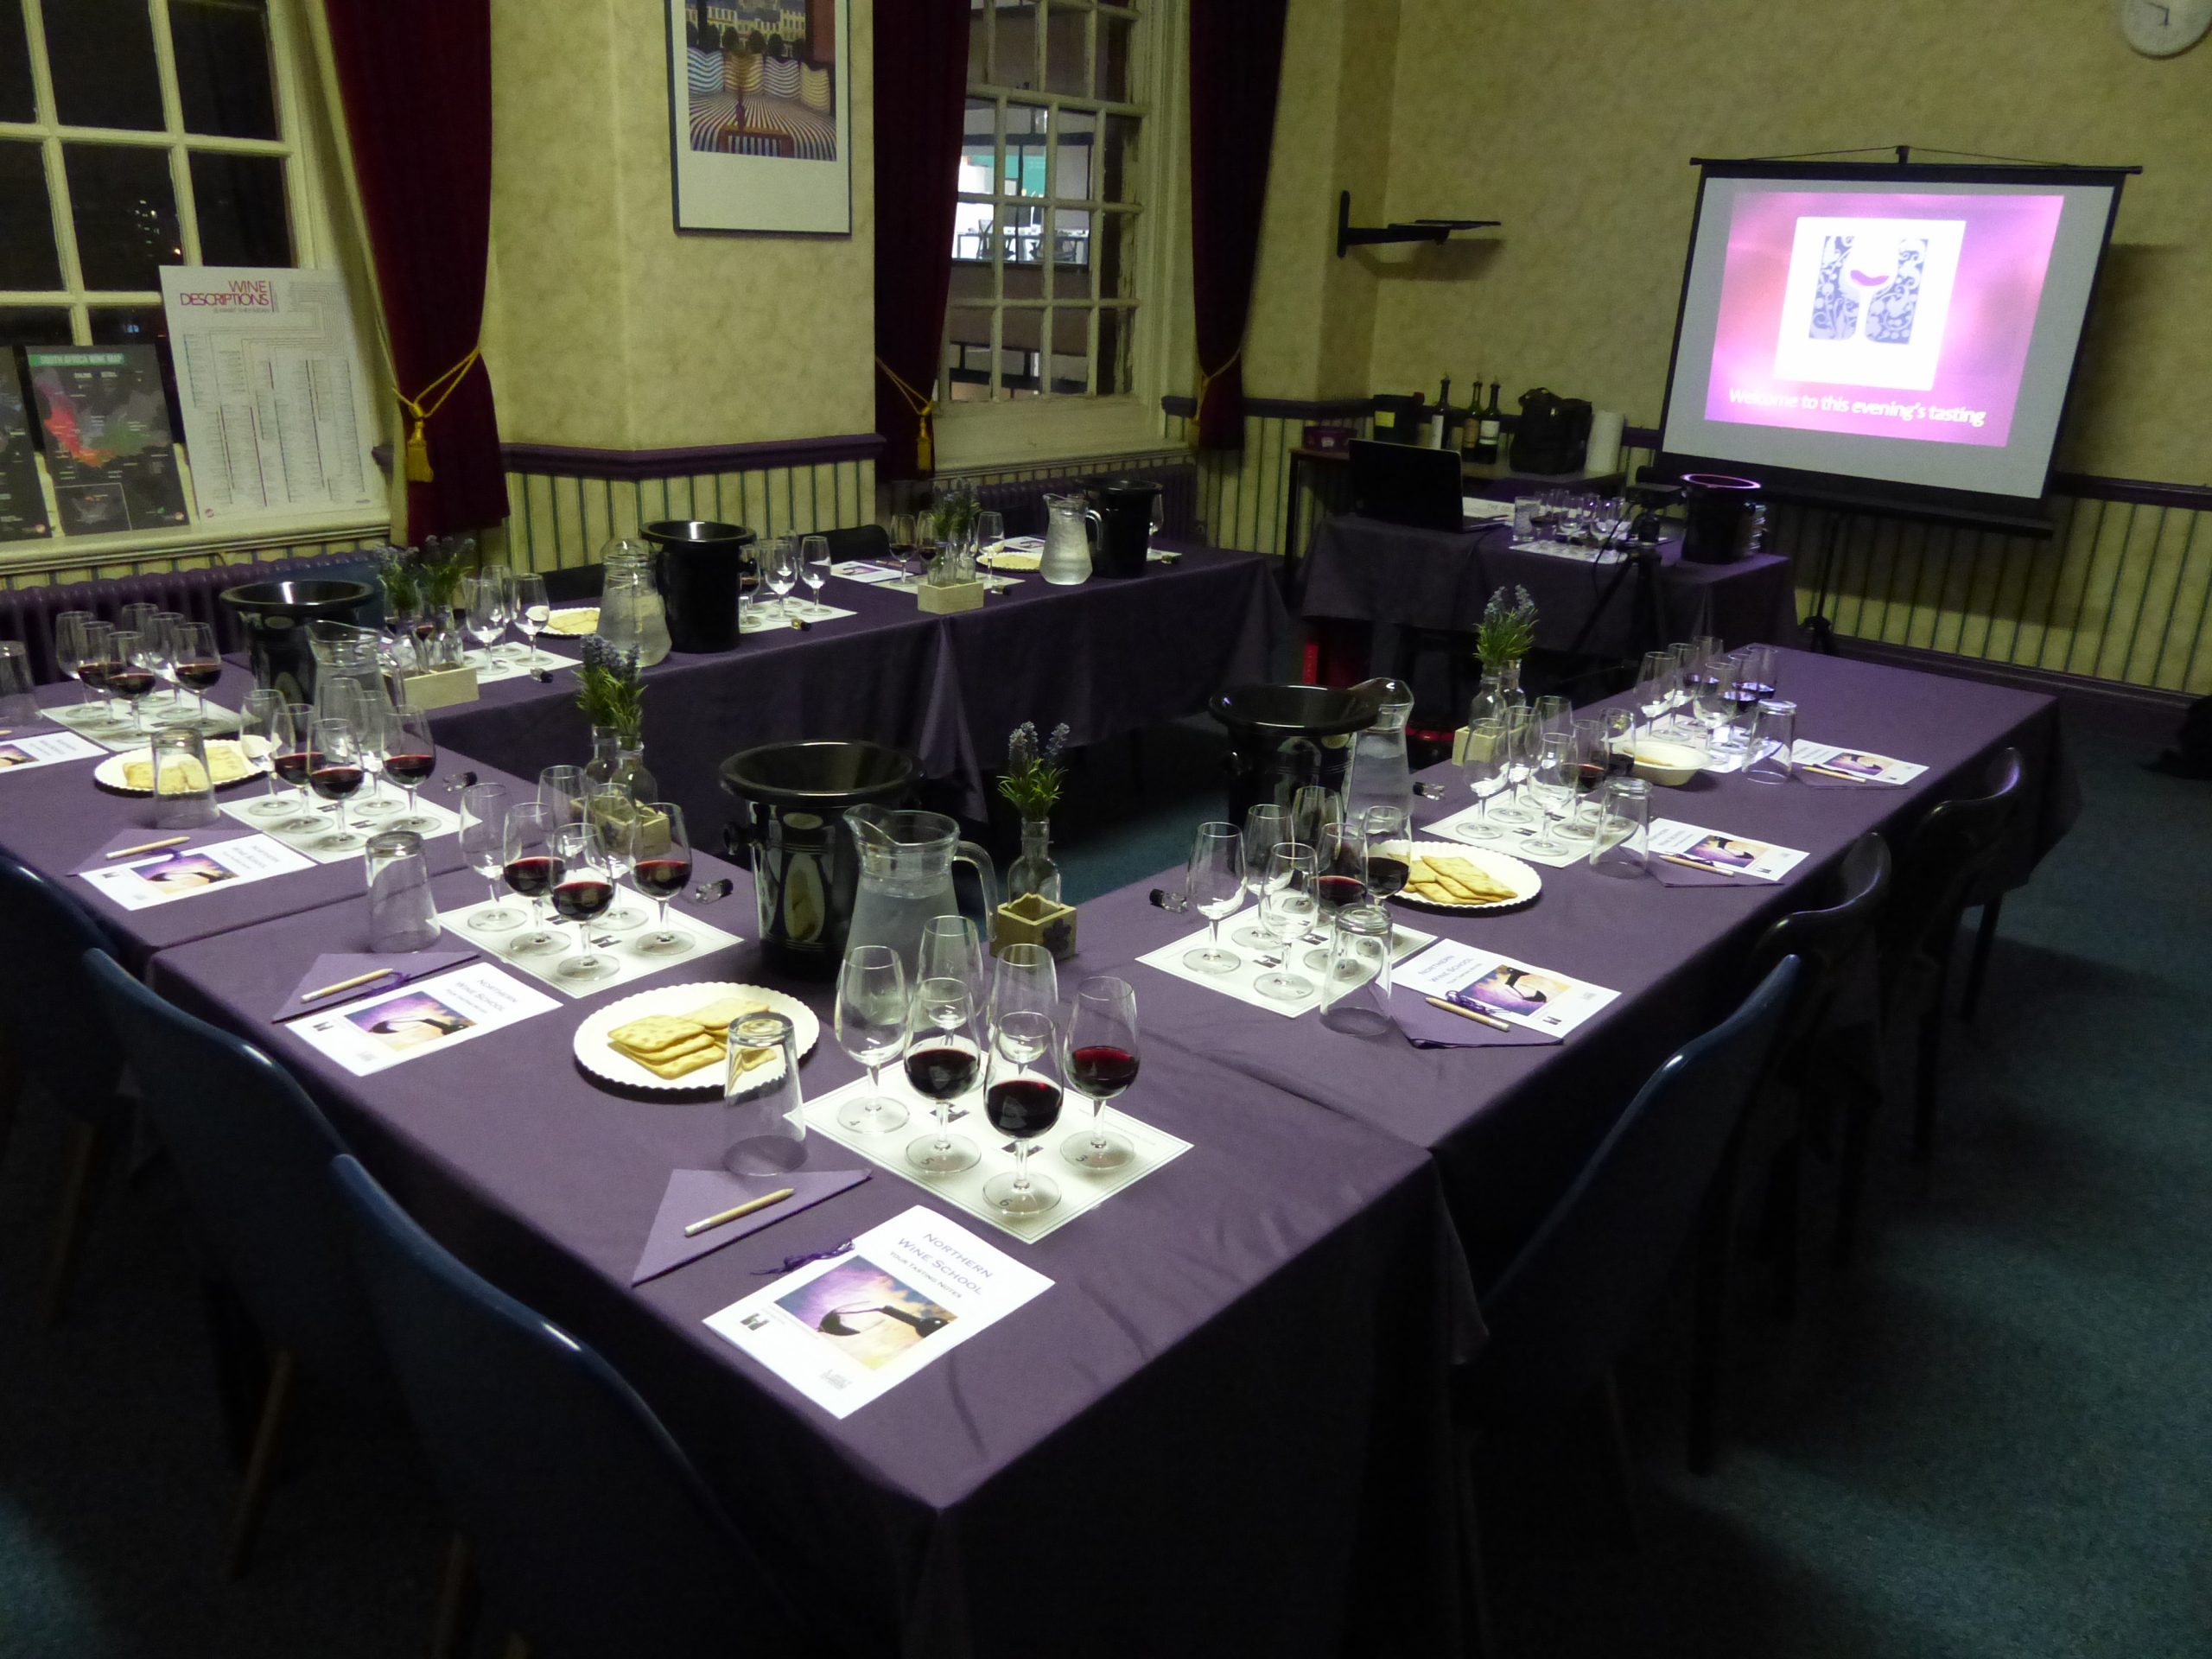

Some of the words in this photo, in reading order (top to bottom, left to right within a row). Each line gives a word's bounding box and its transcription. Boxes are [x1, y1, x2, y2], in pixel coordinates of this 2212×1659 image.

[180, 293, 270, 306] DESCRIPTIONS
[228, 281, 268, 293] WINE
[1729, 387, 1799, 408] Welcome
[1801, 395, 1818, 409] to
[1821, 394, 1849, 412] this
[1852, 400, 1926, 421] evening's
[1929, 405, 1986, 427] tasting
[898, 1237, 933, 1262] WINE
[931, 1259, 982, 1295] SCHOOL
[923, 1233, 993, 1278] NORTHERN
